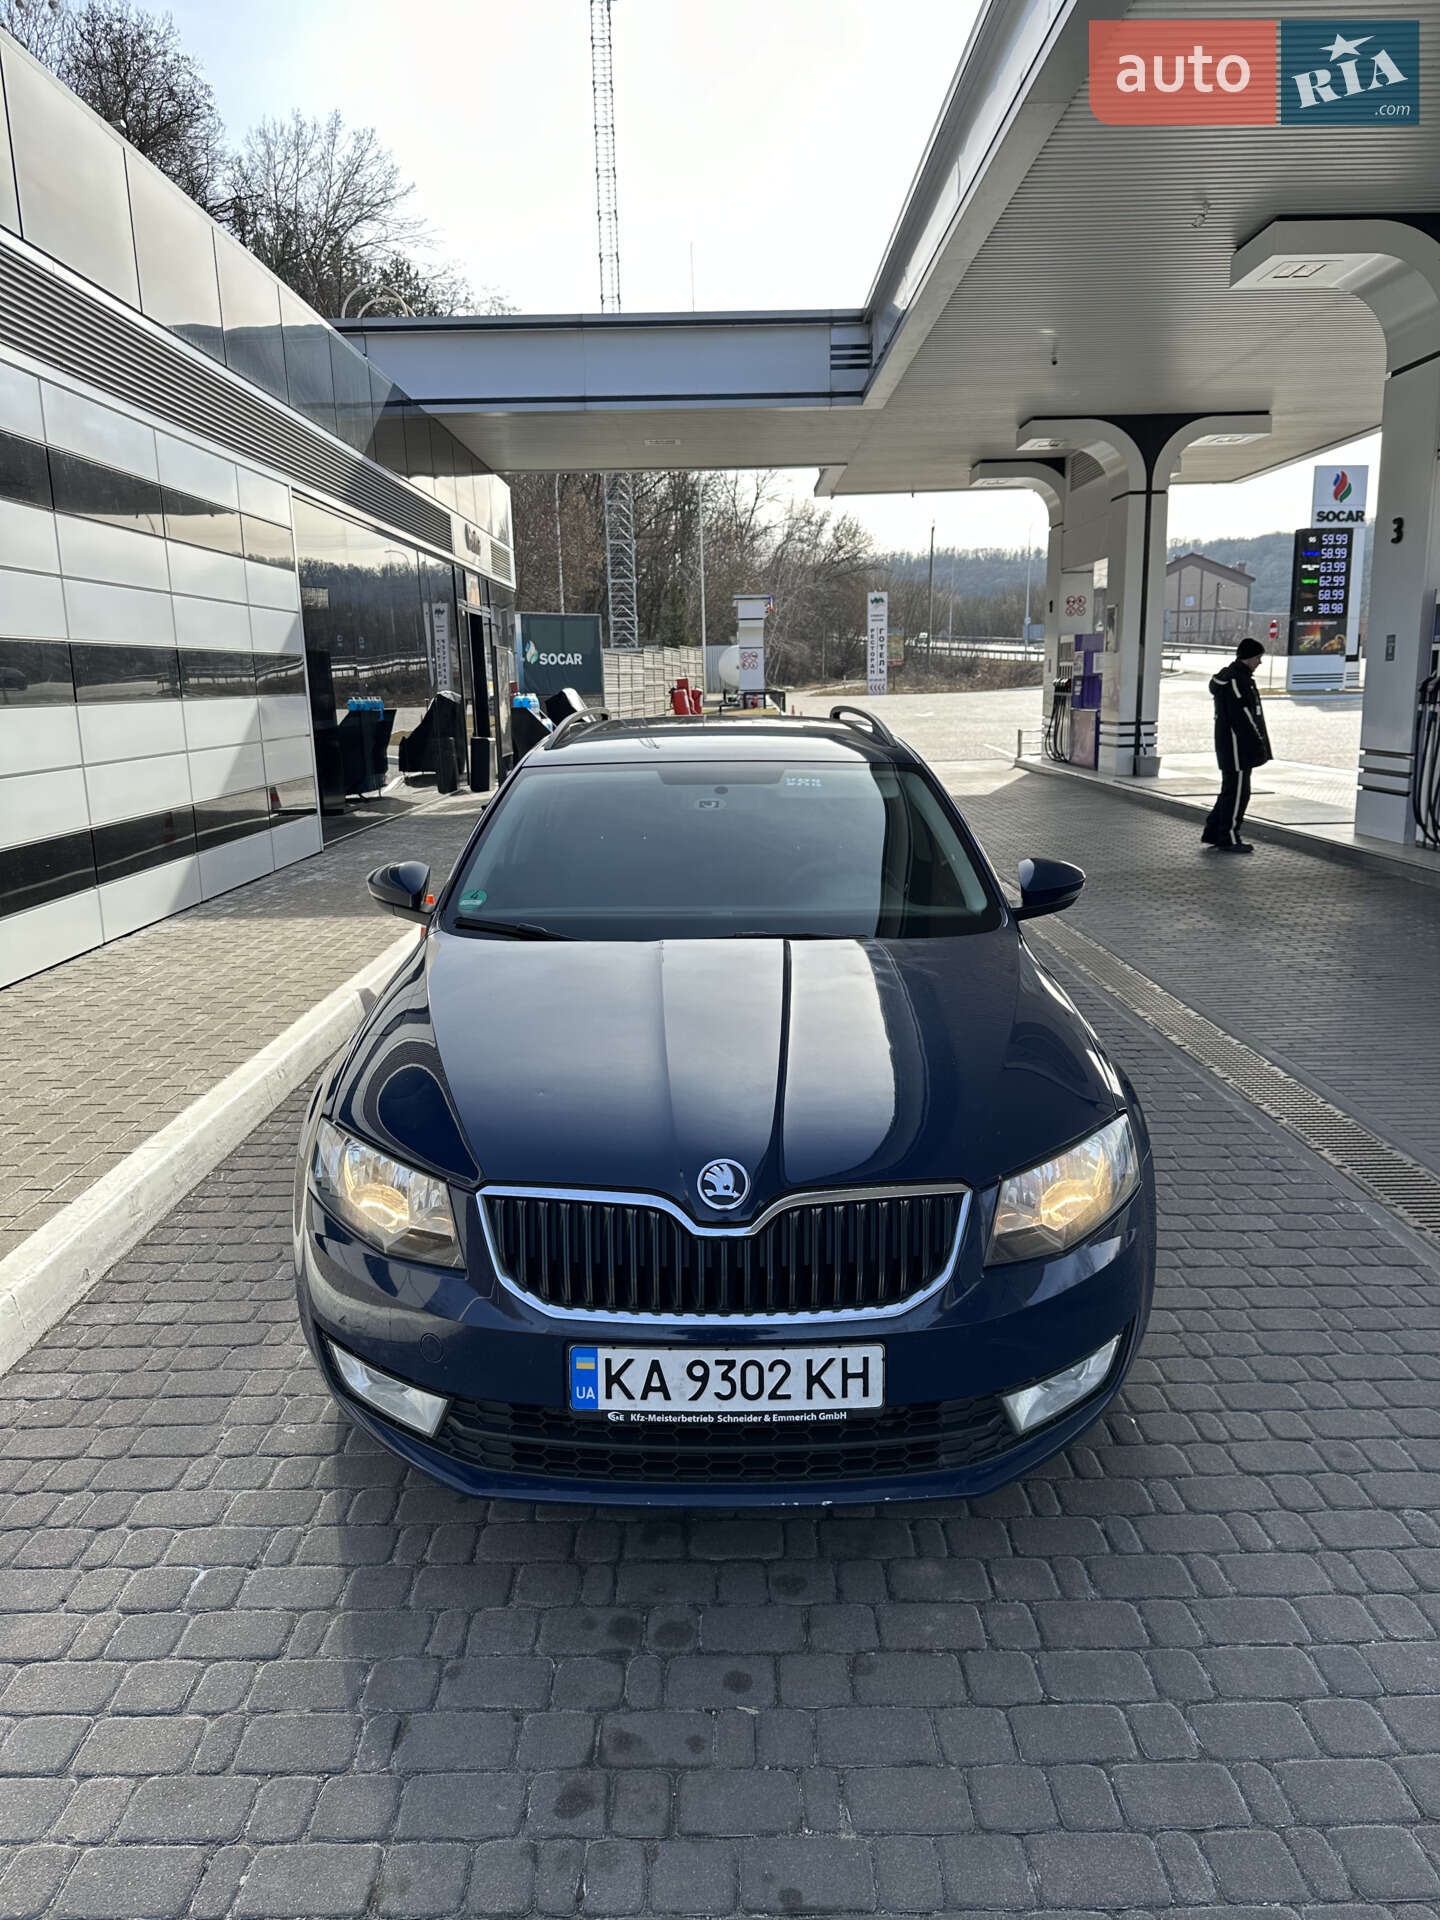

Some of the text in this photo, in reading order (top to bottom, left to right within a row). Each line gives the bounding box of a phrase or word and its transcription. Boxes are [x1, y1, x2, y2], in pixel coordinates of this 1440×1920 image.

[1316, 510, 1366, 523] SOCAR
[1391, 516, 1404, 544] 3
[1322, 534, 1348, 545] 59.99
[1321, 548, 1347, 559] 58.99
[1320, 562, 1346, 573] 63.99
[1319, 576, 1345, 587] 62.99
[1318, 590, 1344, 600] 68.99
[1318, 603, 1344, 614] 38.98
[539, 652, 583, 666] SOCAR
[604, 1356, 870, 1401] KA 9302 KH
[576, 1386, 596, 1400] UA
[630, 1412, 714, 1423] Kfz-Meisterbetrieb
[717, 1413, 762, 1423] Schneider
[763, 1413, 771, 1422] &
[772, 1412, 817, 1422] Emmerich
[818, 1411, 847, 1421] GmbH
